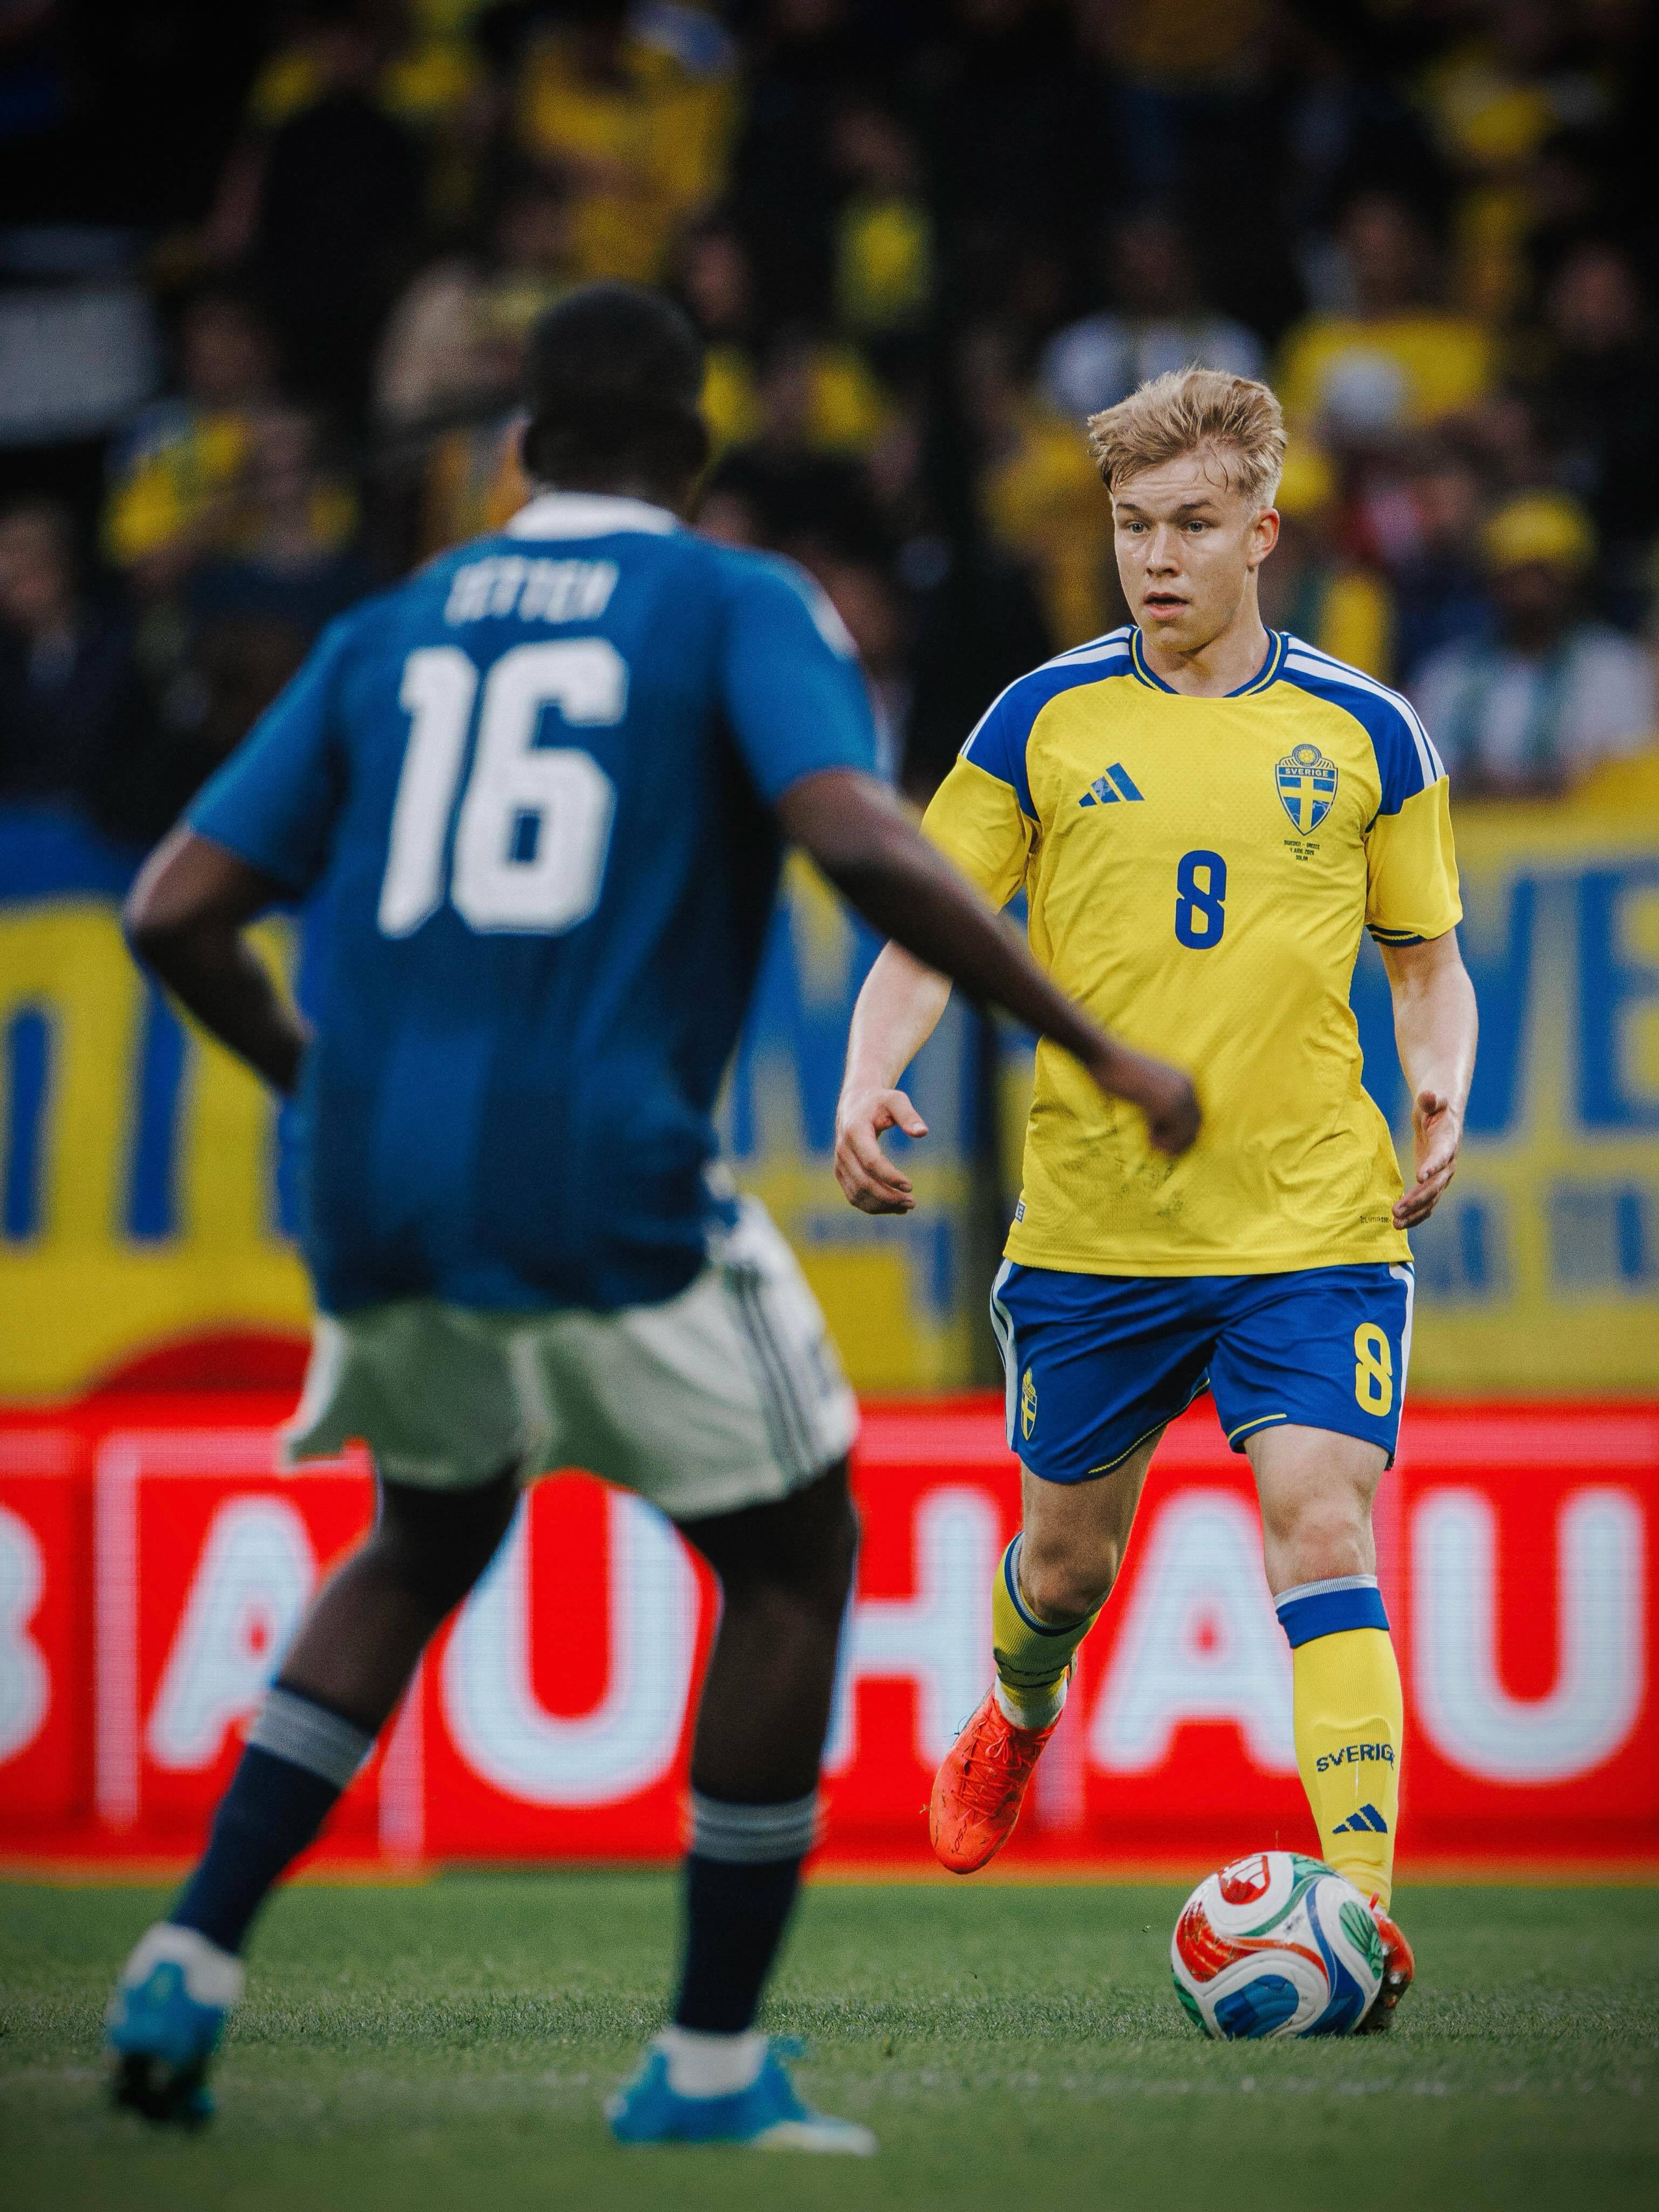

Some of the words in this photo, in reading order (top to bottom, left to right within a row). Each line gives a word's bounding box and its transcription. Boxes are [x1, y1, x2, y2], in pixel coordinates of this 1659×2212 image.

[376, 637, 631, 940] 16
[1285, 767, 1328, 777] SVERIGE
[1175, 850, 1227, 949] 8
[1354, 1323, 1392, 1417] 8
[0, 1488, 1647, 1806] AUHAU
